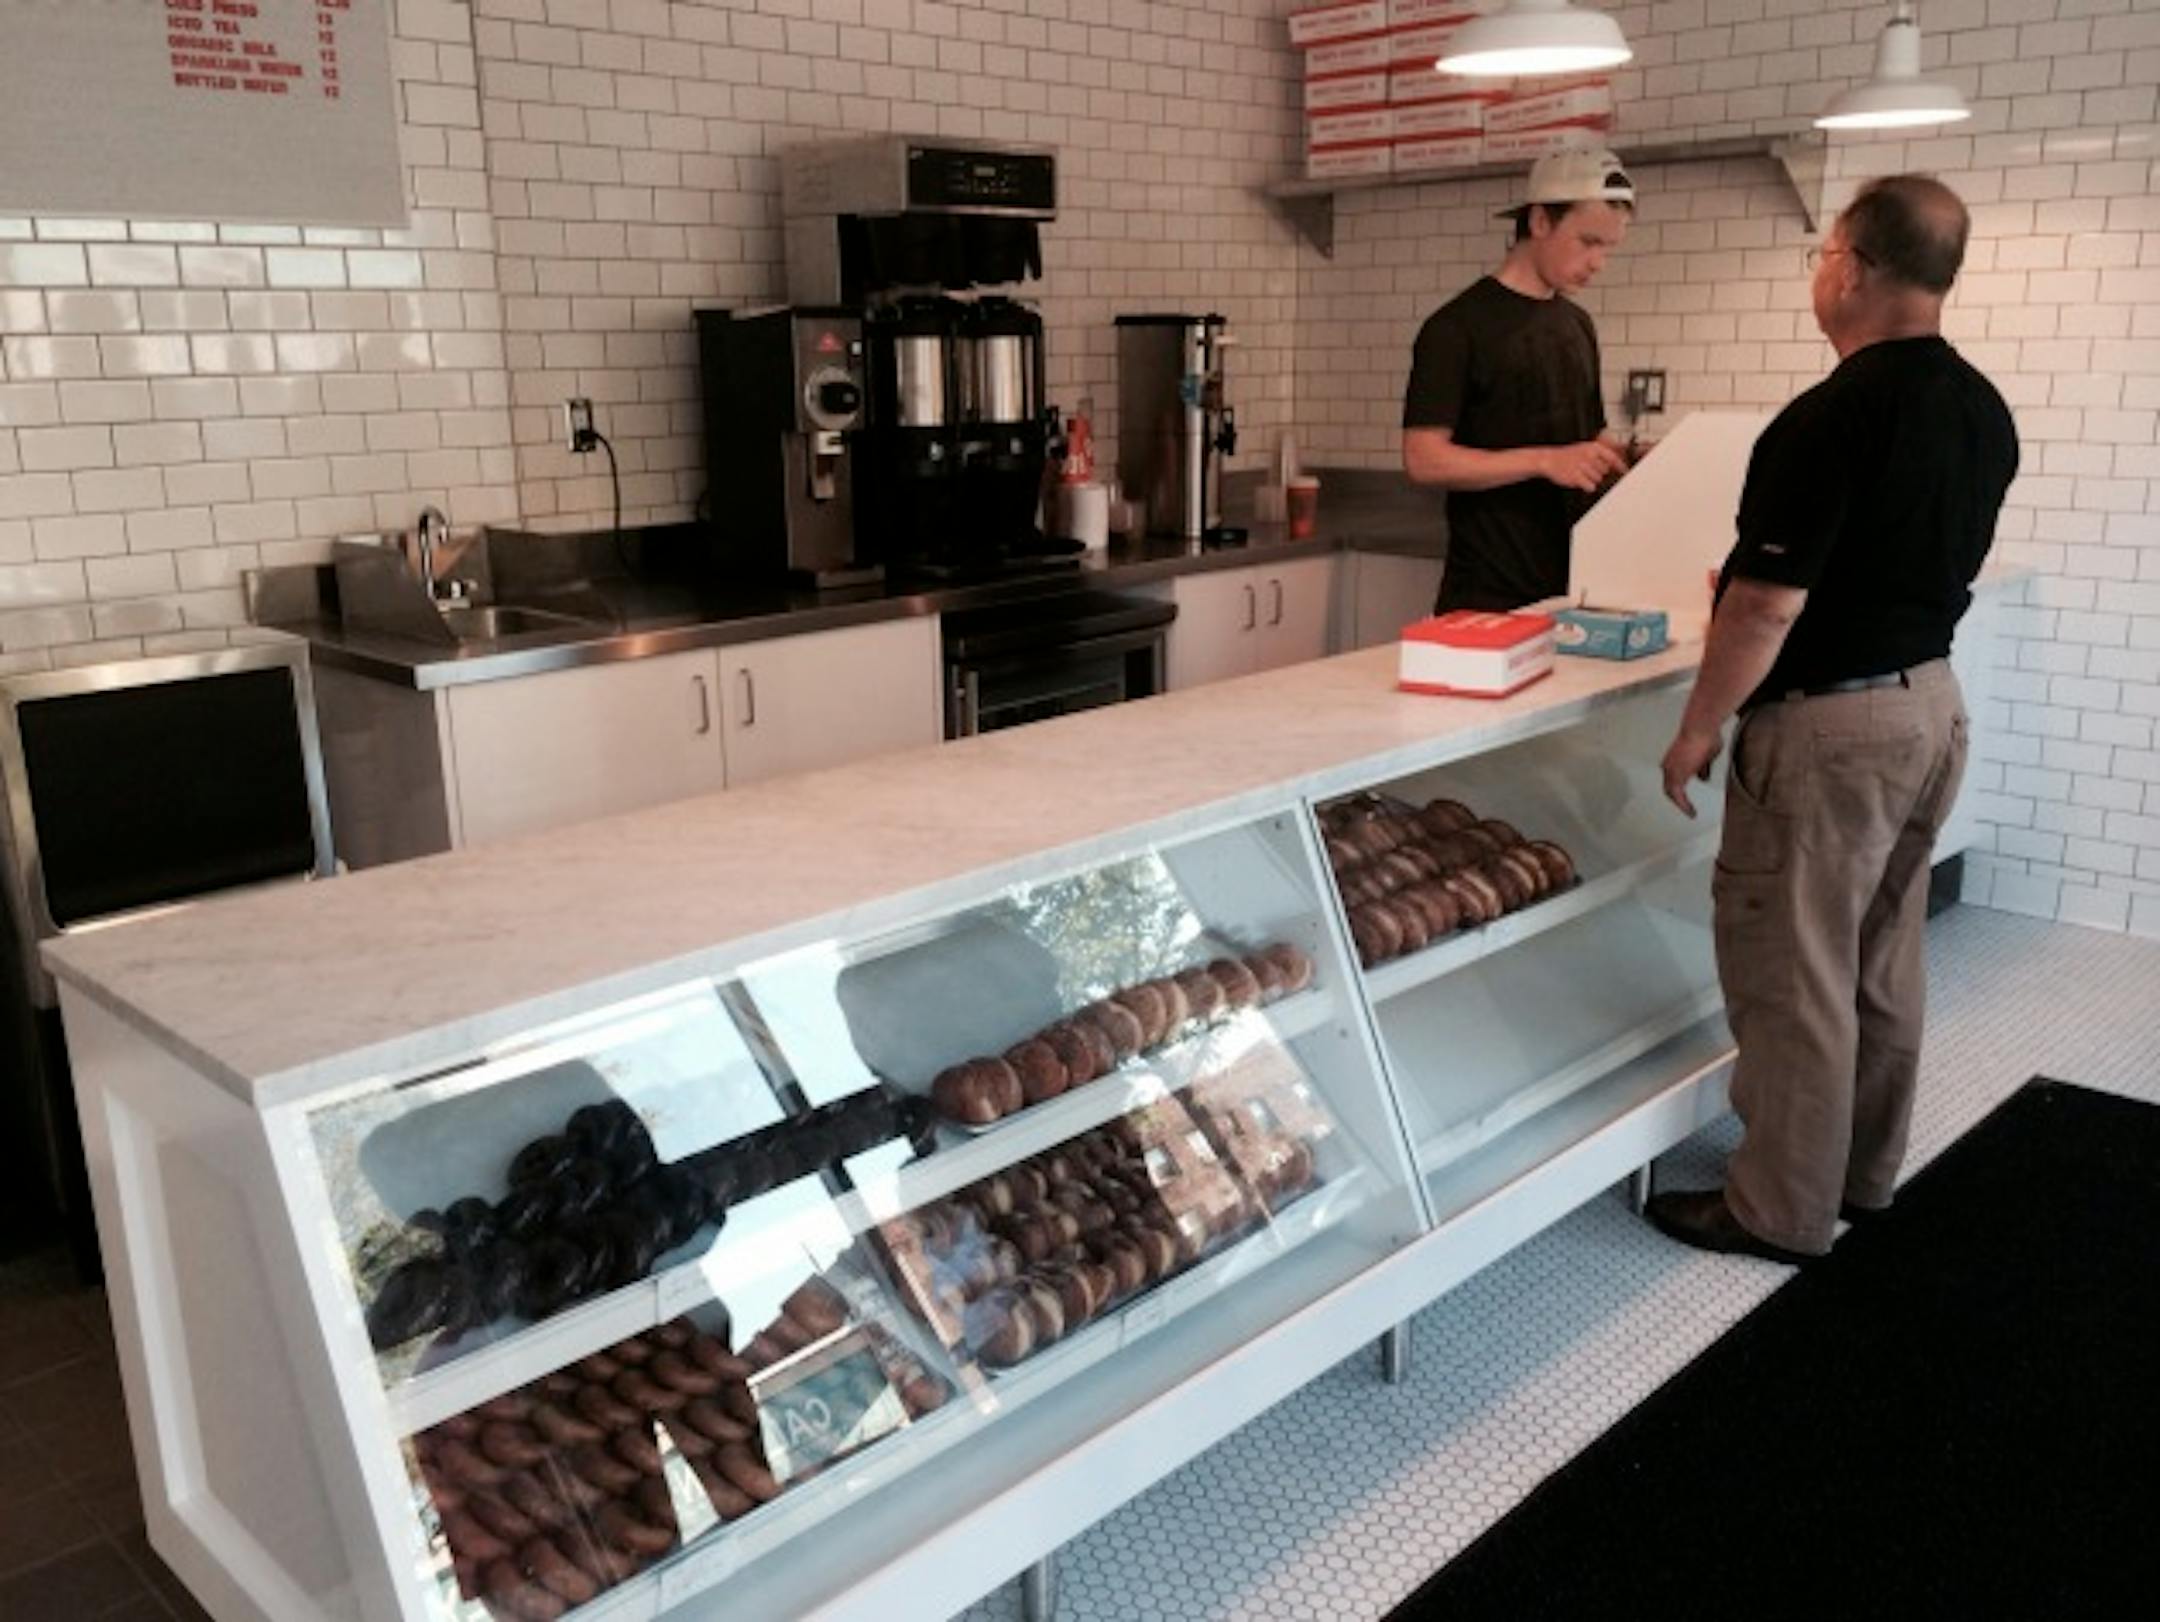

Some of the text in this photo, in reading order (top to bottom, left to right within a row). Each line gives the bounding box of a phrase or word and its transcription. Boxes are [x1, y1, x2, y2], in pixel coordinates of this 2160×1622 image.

[167, 13, 202, 31] ICED
[212, 18, 241, 35] TEA
[167, 34, 233, 53] ORGANIC
[171, 53, 251, 73] SPARKLING
[175, 72, 237, 91] BOTTLED
[243, 79, 288, 95] WATER
